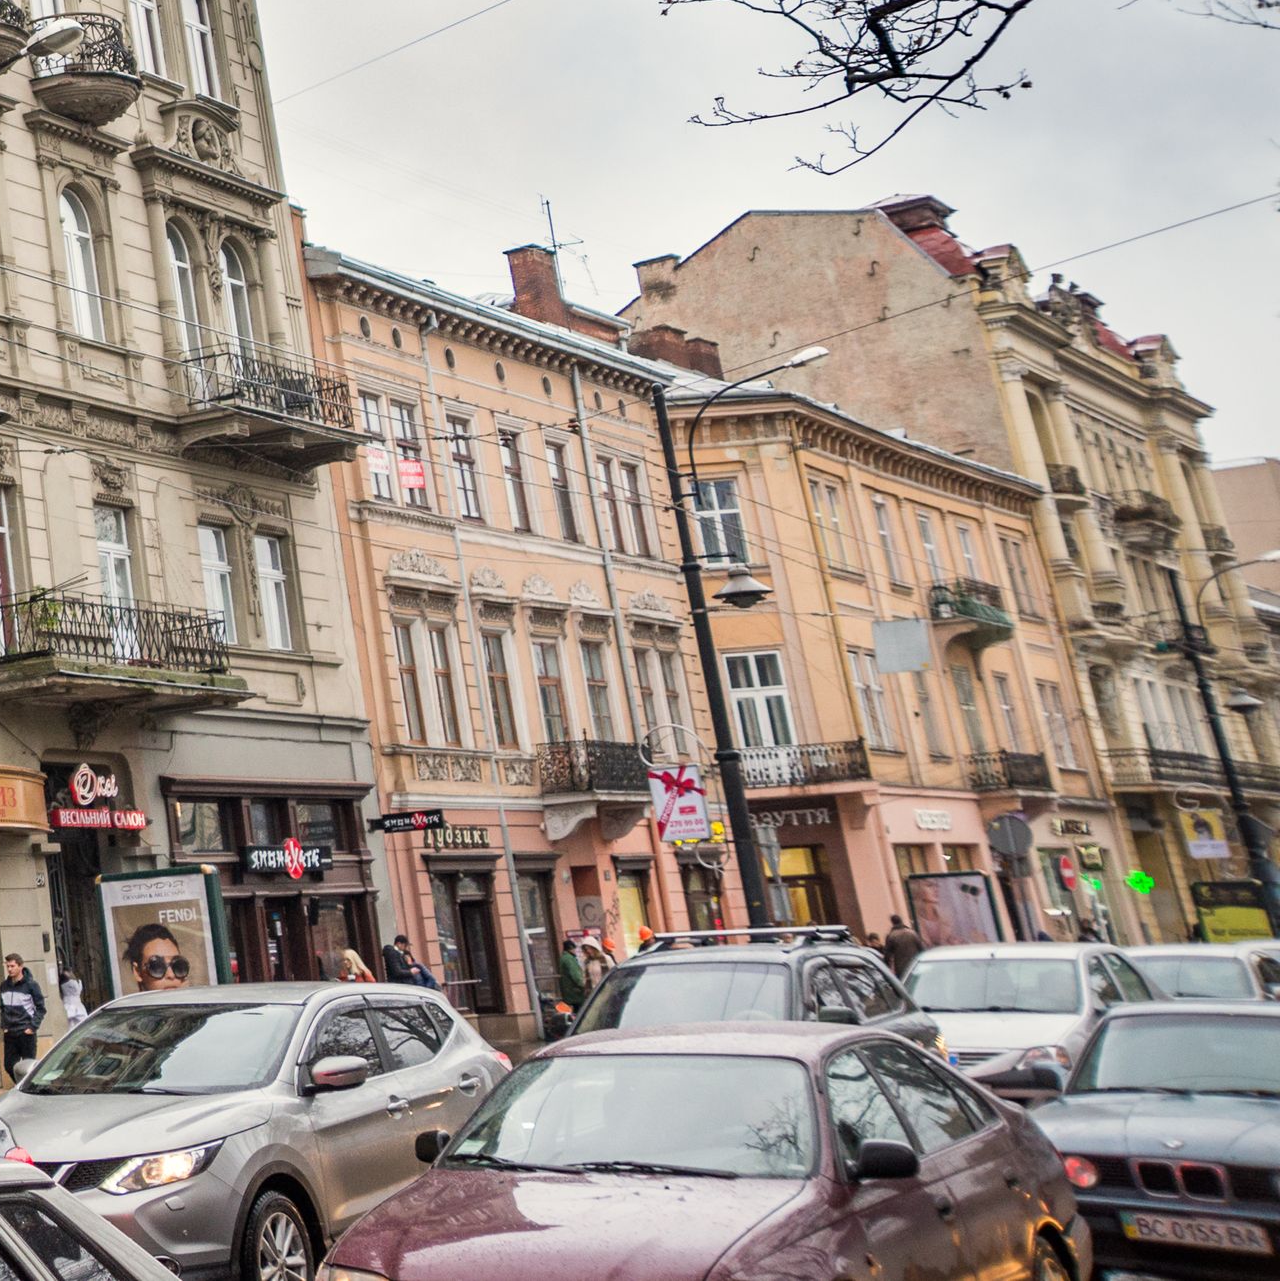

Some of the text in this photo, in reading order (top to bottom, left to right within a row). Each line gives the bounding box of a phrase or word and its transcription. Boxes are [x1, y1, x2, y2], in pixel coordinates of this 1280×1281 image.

[60, 809, 146, 826] ВЕСІЛЬНИЙ САЛОН
[158, 907, 197, 923] FENDI
[1137, 1218, 1166, 1238] BC
